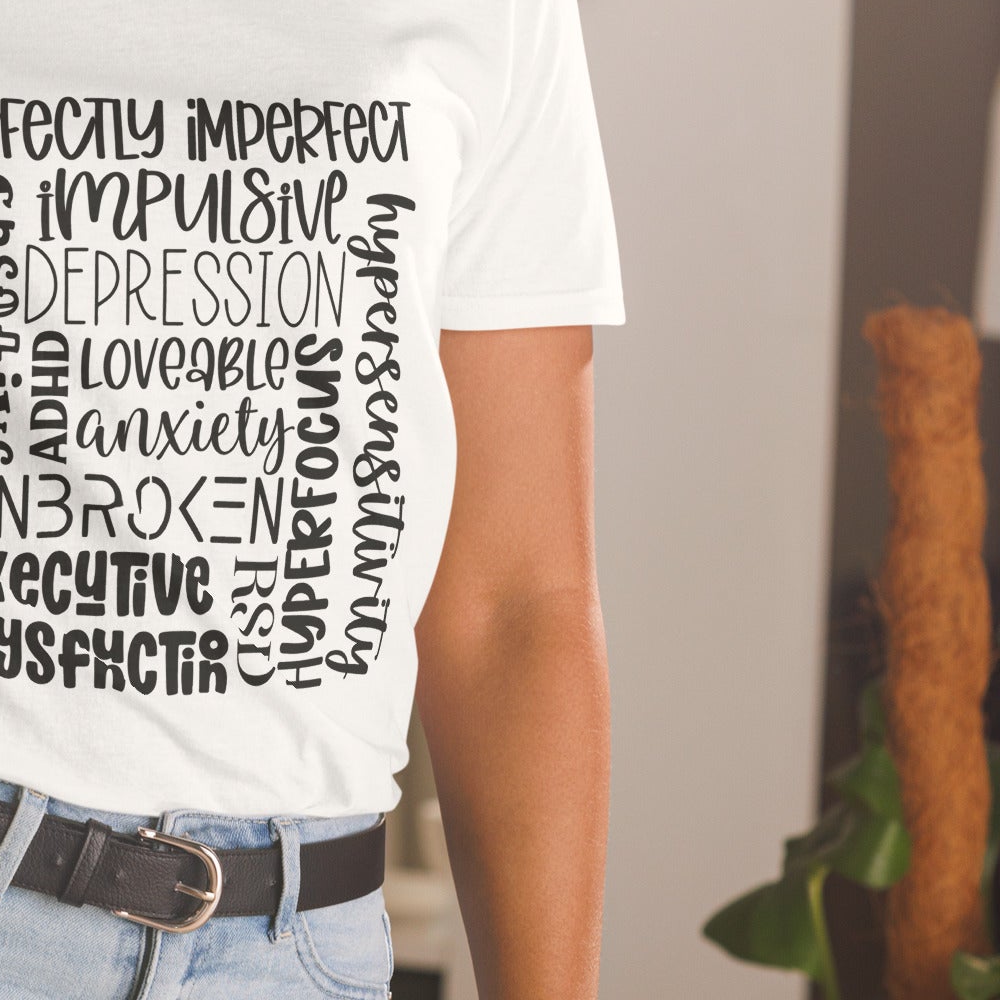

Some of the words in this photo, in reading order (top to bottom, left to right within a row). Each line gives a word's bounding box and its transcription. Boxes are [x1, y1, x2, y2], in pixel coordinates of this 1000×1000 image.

[24, 244, 346, 328] DEPRESSION
[28, 330, 70, 465] ADHD
[75, 396, 295, 476] anxiety
[324, 193, 416, 679] hypersensitivity
[277, 333, 344, 689] HYPERFOCUS
[230, 556, 279, 687] RSD
